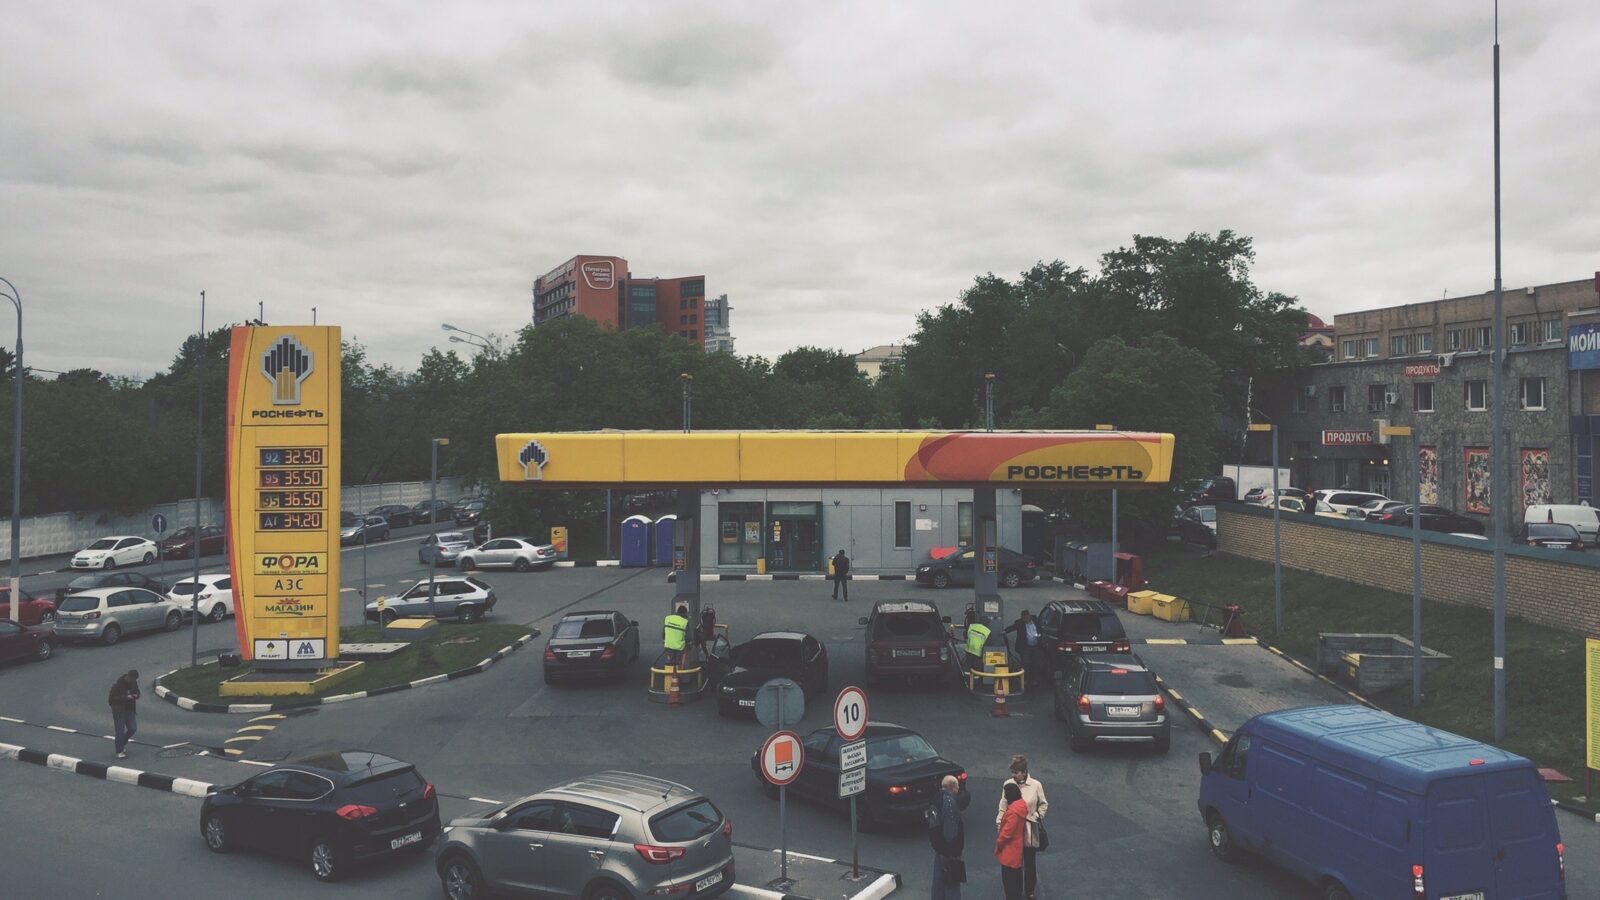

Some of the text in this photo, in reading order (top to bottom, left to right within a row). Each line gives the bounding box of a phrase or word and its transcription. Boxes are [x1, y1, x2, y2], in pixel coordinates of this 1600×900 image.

[1405, 365, 1440, 376] ПРОДУКТЫ
[252, 410, 324, 418] РОСНЕФТЬ
[265, 449, 320, 464] 92 32.50
[265, 471, 320, 485] 95 35.50
[1007, 465, 1143, 480] РОСНЕФТЬ
[263, 492, 320, 507] 95 36.50
[264, 513, 320, 527] ДТ 34.20
[262, 554, 319, 571] ФОРА
[274, 579, 304, 590] АЗС
[265, 604, 314, 612] МАГАЗИН
[843, 702, 860, 724] 10
